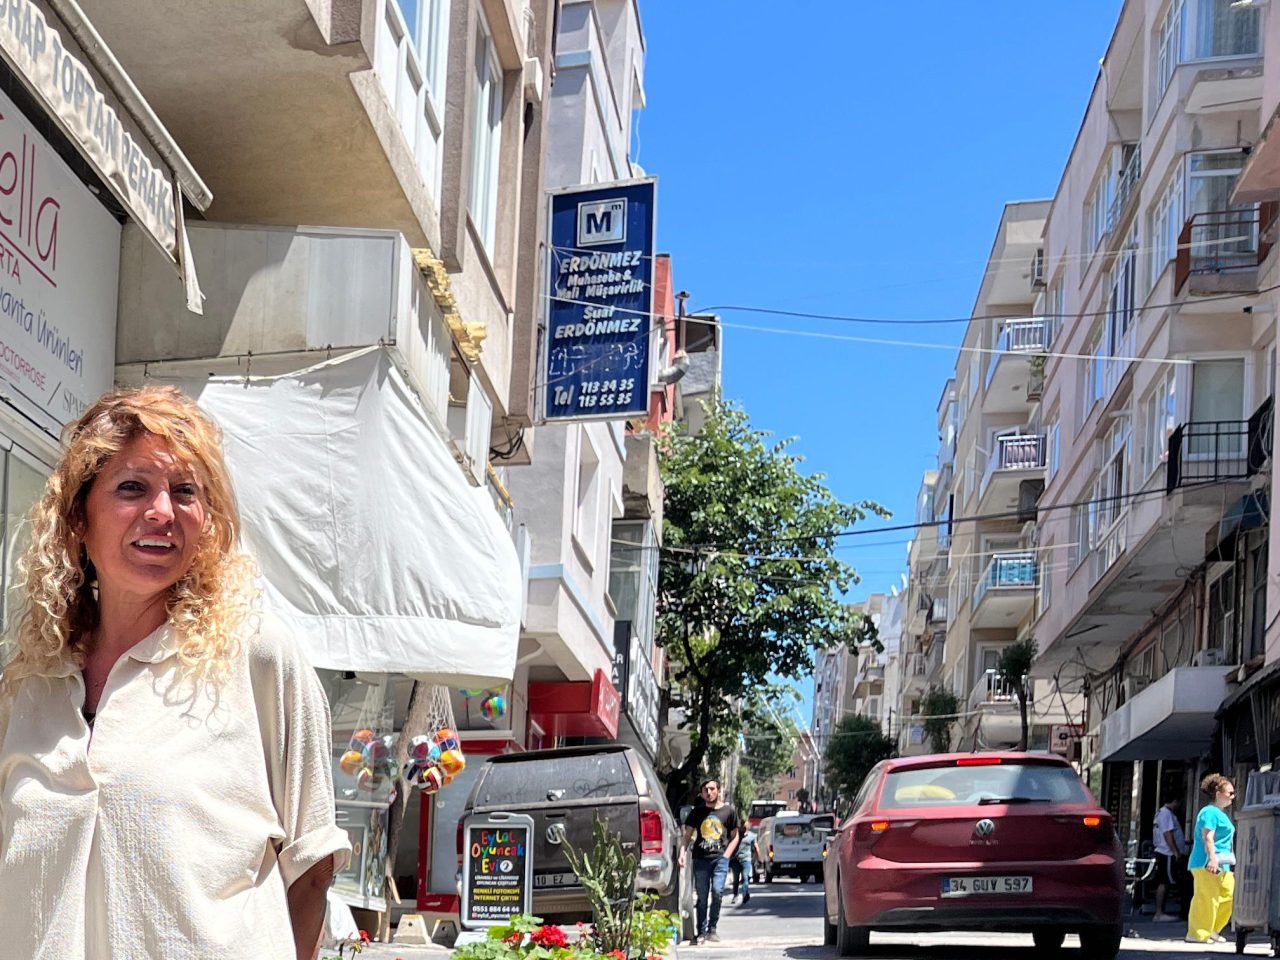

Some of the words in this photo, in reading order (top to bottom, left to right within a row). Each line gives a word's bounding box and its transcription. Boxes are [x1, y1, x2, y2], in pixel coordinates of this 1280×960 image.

[53, 36, 119, 160] TOPTAN
[560, 250, 642, 274] ERDÖNMEZ
[567, 270, 621, 287] Muhasebe
[585, 279, 644, 298] Müşavirlik
[555, 319, 641, 339] ERDÖNMEZ
[37, 308, 83, 378] Ürünleri
[555, 385, 574, 405] Tel
[601, 379, 617, 392] 34
[619, 378, 634, 391] 35
[599, 394, 615, 406] 55
[617, 392, 632, 405] 35
[472, 843, 524, 858] Oyuncak
[482, 859, 499, 873] Evi
[536, 875, 546, 885] 10
[553, 873, 564, 884] EZ
[951, 880, 966, 892] 34
[973, 879, 998, 891] GUV
[1004, 878, 1029, 891] 597
